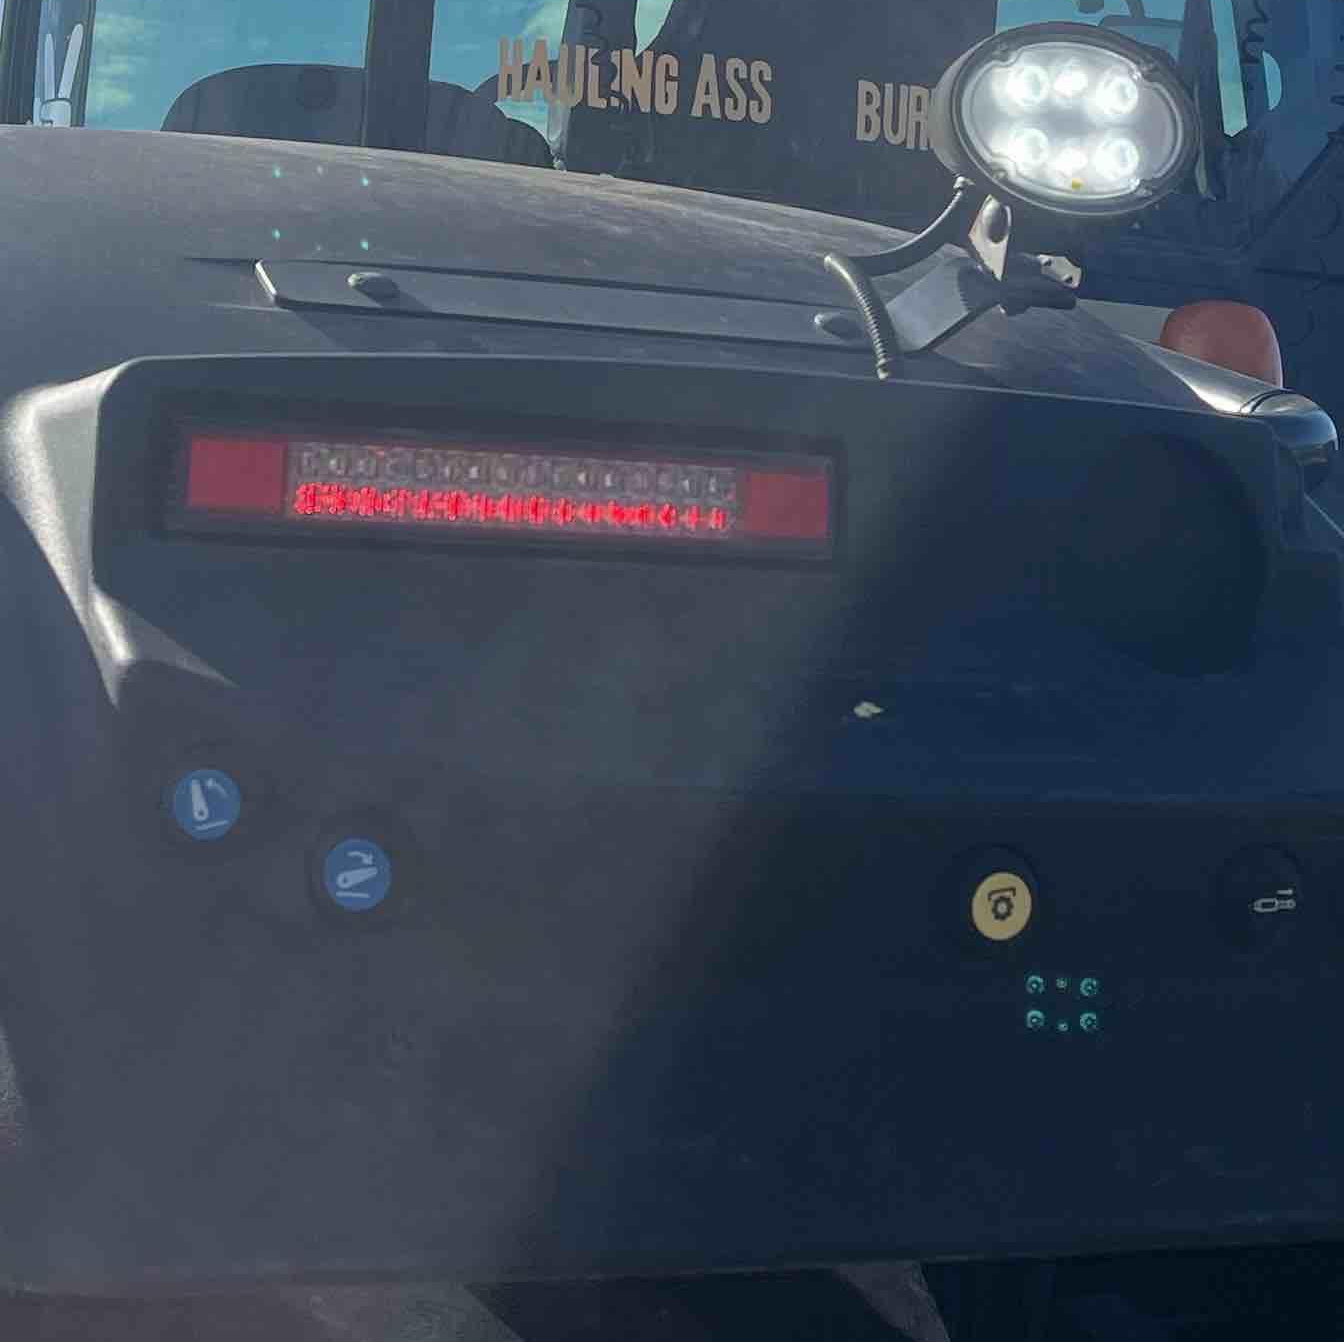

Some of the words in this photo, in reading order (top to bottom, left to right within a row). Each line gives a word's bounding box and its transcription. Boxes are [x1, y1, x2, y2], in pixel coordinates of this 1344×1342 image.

[498, 35, 679, 115] HAULING
[691, 53, 773, 124] ASS
[856, 79, 938, 151] BUR
